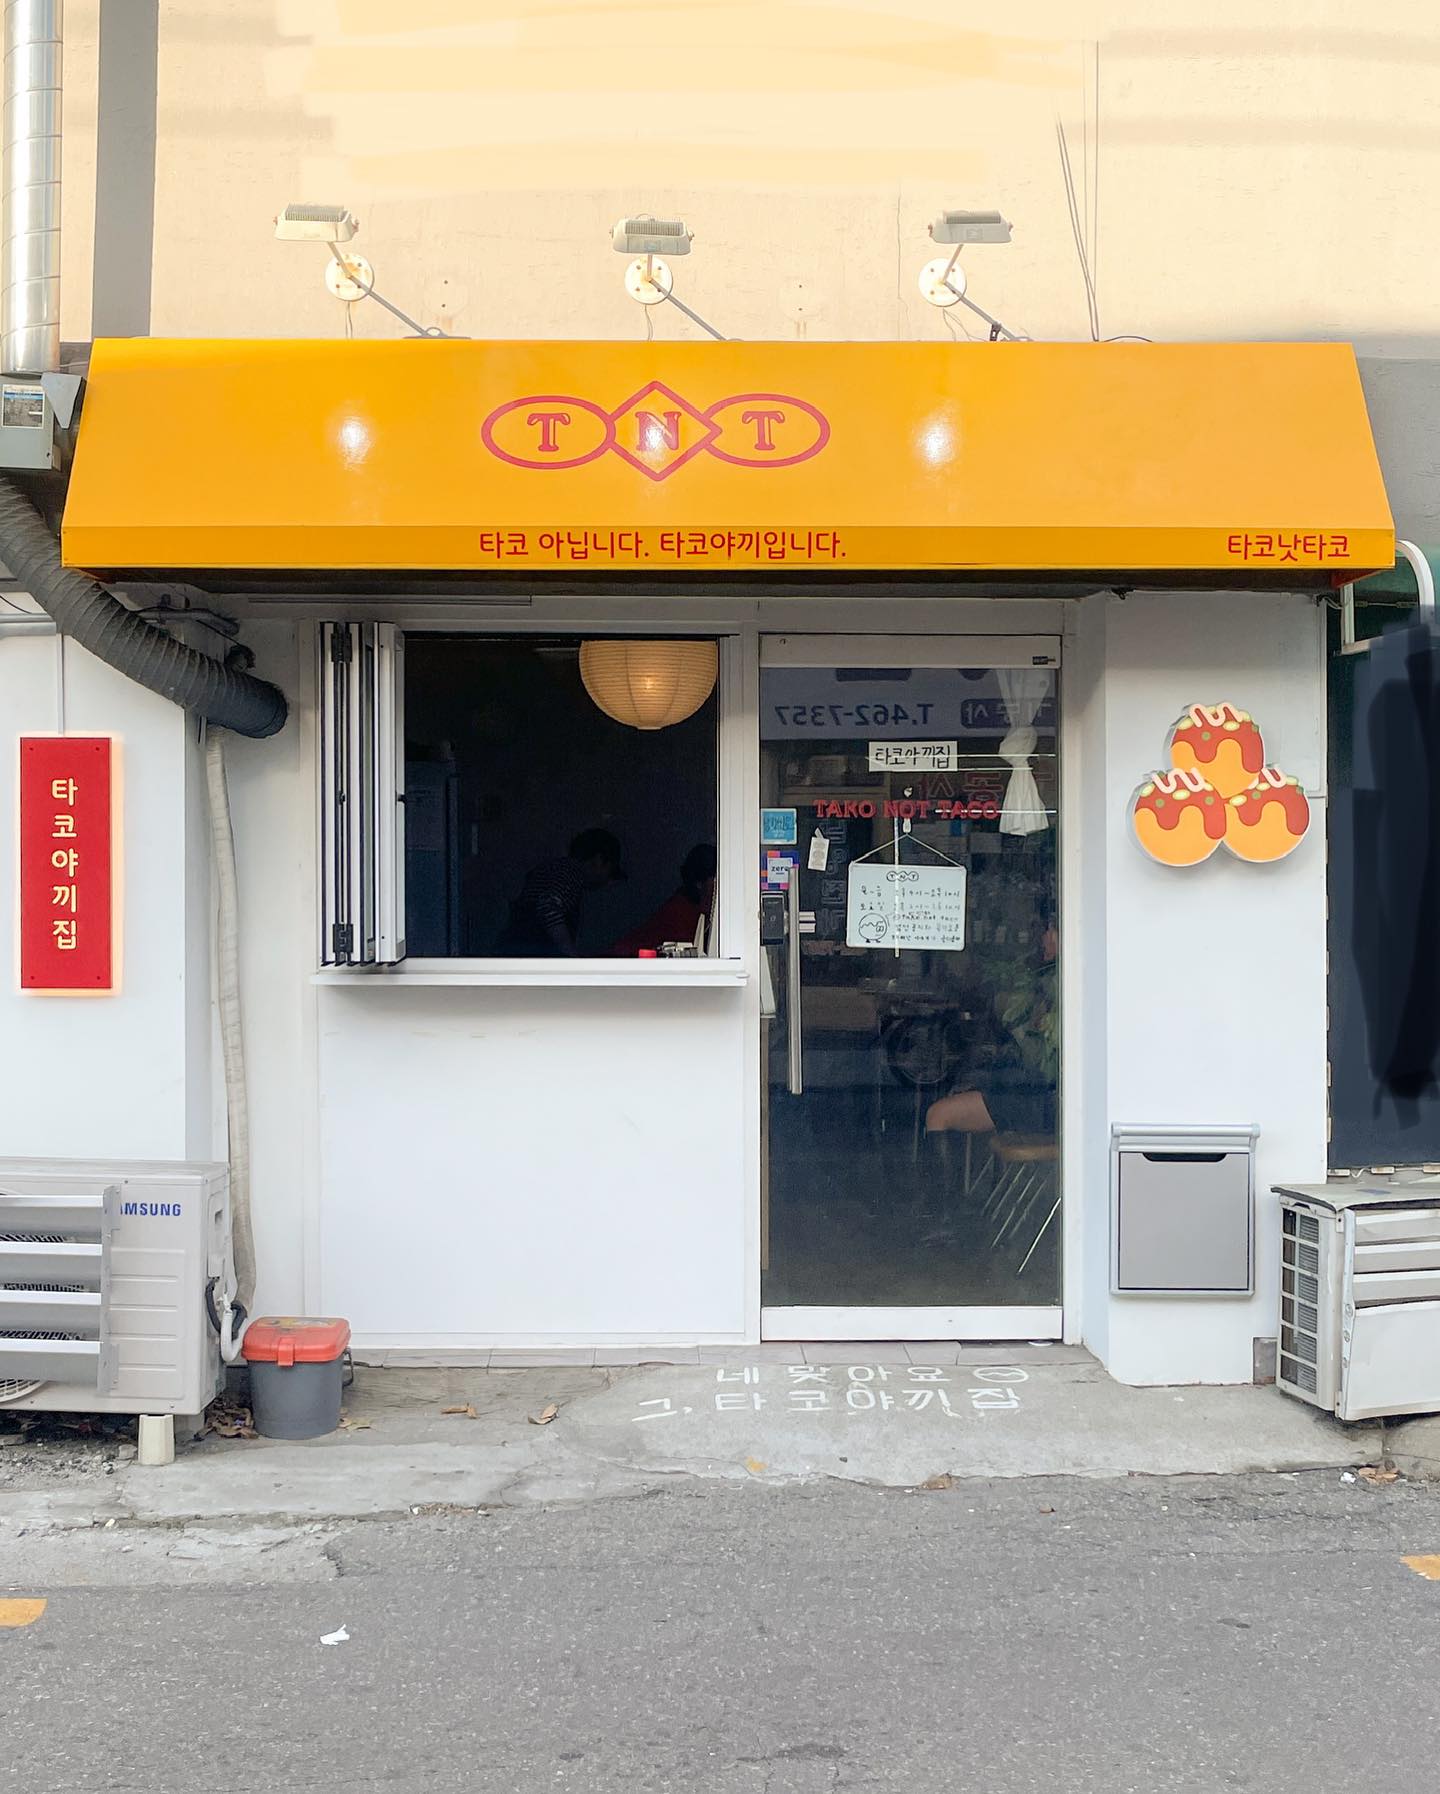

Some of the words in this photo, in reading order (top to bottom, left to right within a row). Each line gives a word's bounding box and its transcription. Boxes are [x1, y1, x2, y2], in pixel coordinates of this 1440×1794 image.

[479, 531, 529, 560] 타코
[538, 531, 650, 560] 아닙니다.
[660, 531, 847, 560] 타코야끼입니다.
[1227, 534, 1351, 562] 타코낫타코
[814, 799, 877, 818] TAKO
[884, 800, 932, 819] NOT
[939, 801, 1000, 820] TACO
[51, 778, 79, 949] 타코야끼집
[120, 1202, 181, 1217] MSUNG
[715, 1366, 760, 1384] 네
[714, 1386, 1021, 1415] 타코야끼집
